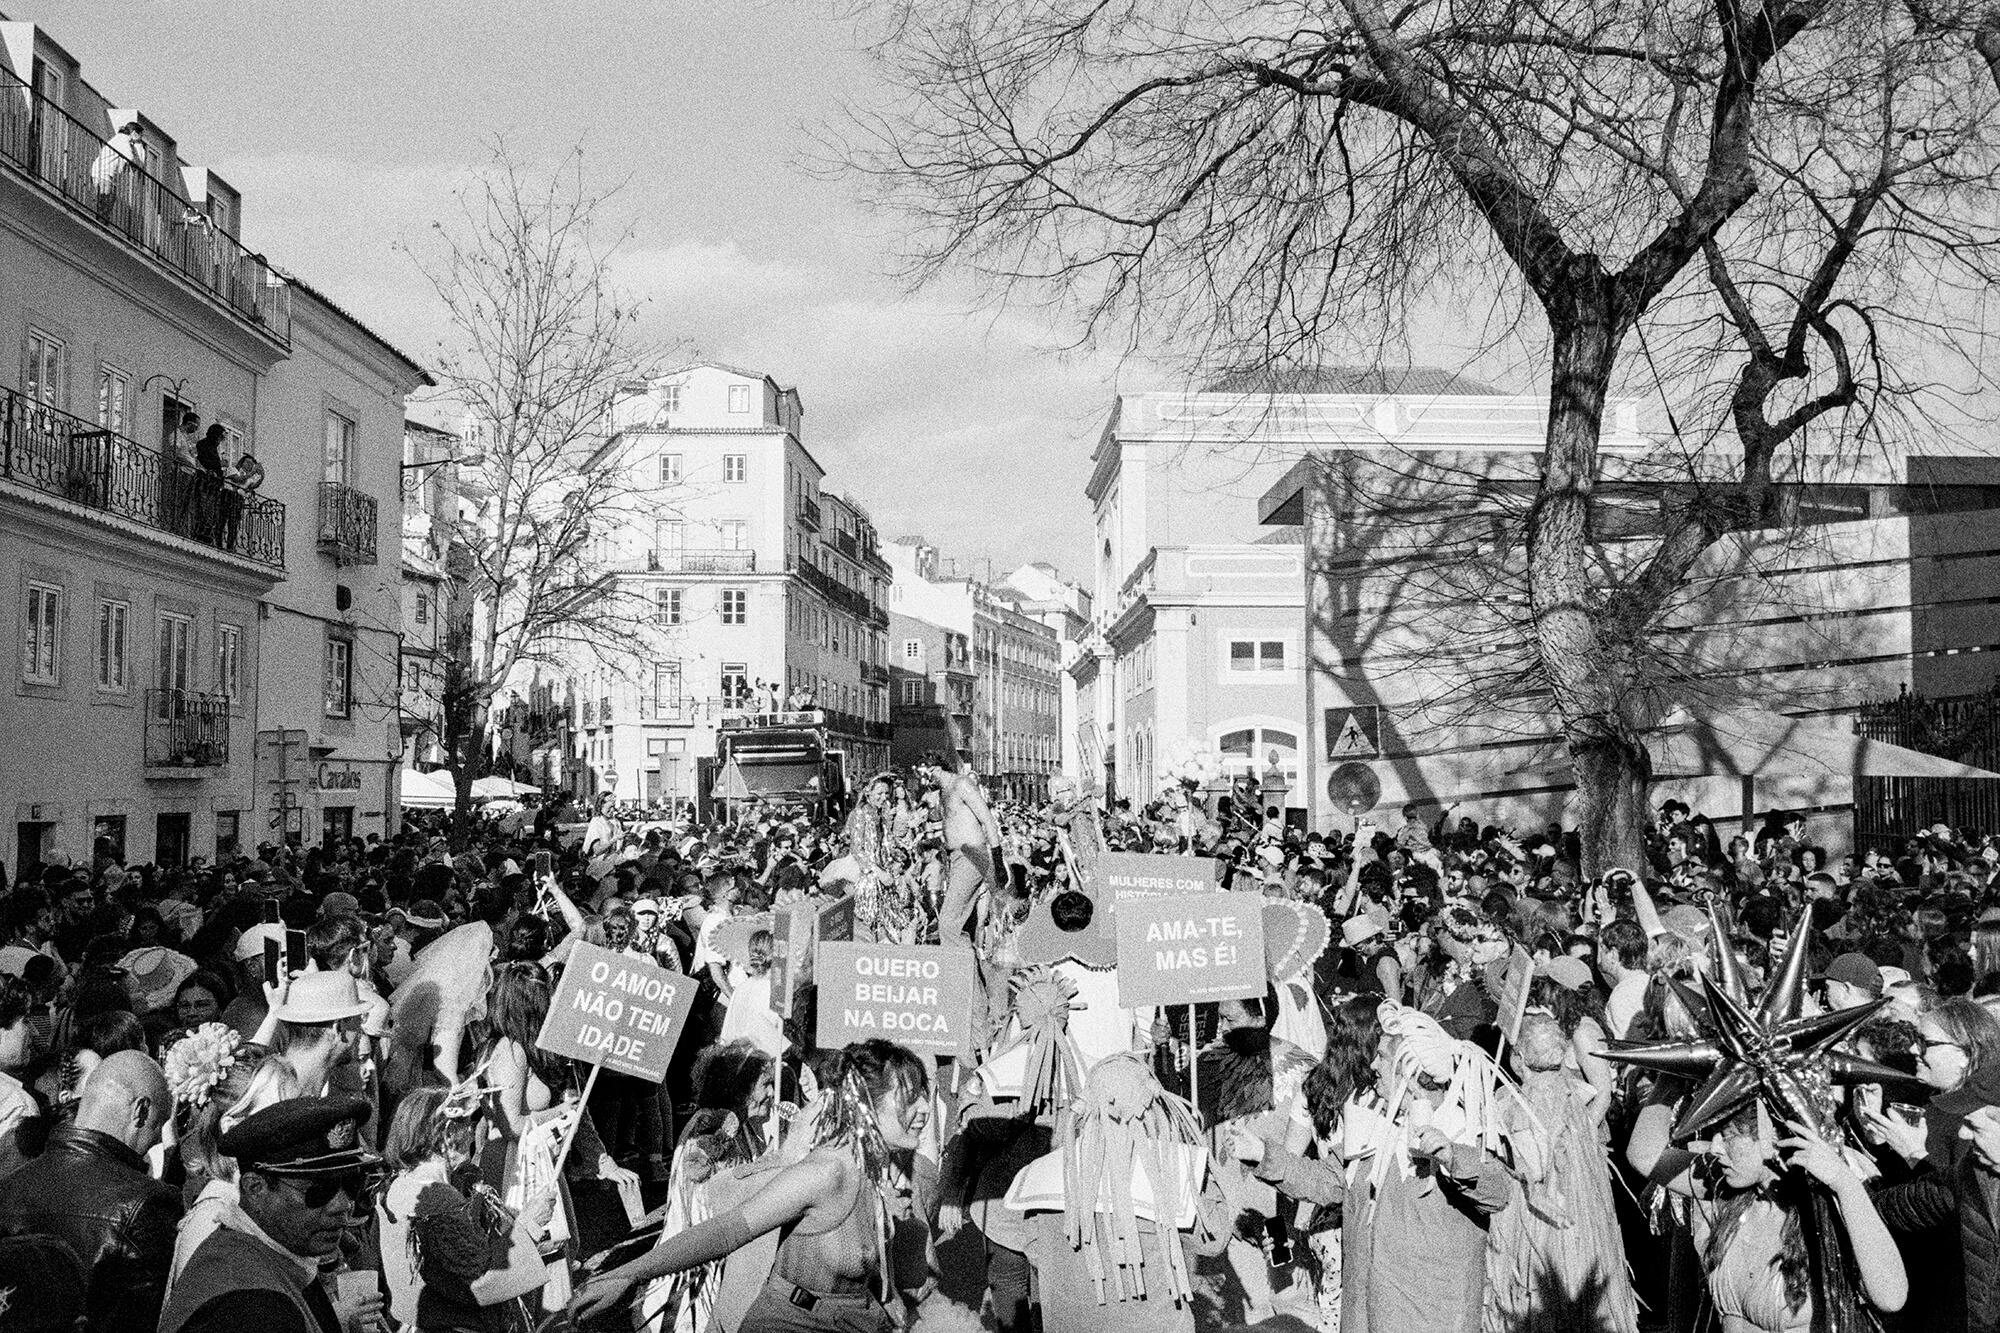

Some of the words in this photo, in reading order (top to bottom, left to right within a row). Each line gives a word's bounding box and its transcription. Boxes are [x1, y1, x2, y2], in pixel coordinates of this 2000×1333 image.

[1109, 875, 1174, 889] MULHERES
[1176, 879, 1204, 891] COM
[1146, 917, 1243, 942] AMA-TE,
[855, 956, 940, 979] QUERO
[1155, 947, 1208, 970] MAS
[1215, 941, 1237, 967] É!
[591, 961, 610, 983] O
[611, 969, 676, 1007] AMOR
[855, 983, 938, 1005] BEIJAR
[572, 988, 624, 1021] NÃO
[628, 1005, 672, 1037] TEM
[844, 1008, 876, 1028] NA
[882, 1011, 949, 1033] BOCA
[577, 1024, 646, 1061] IDADE
